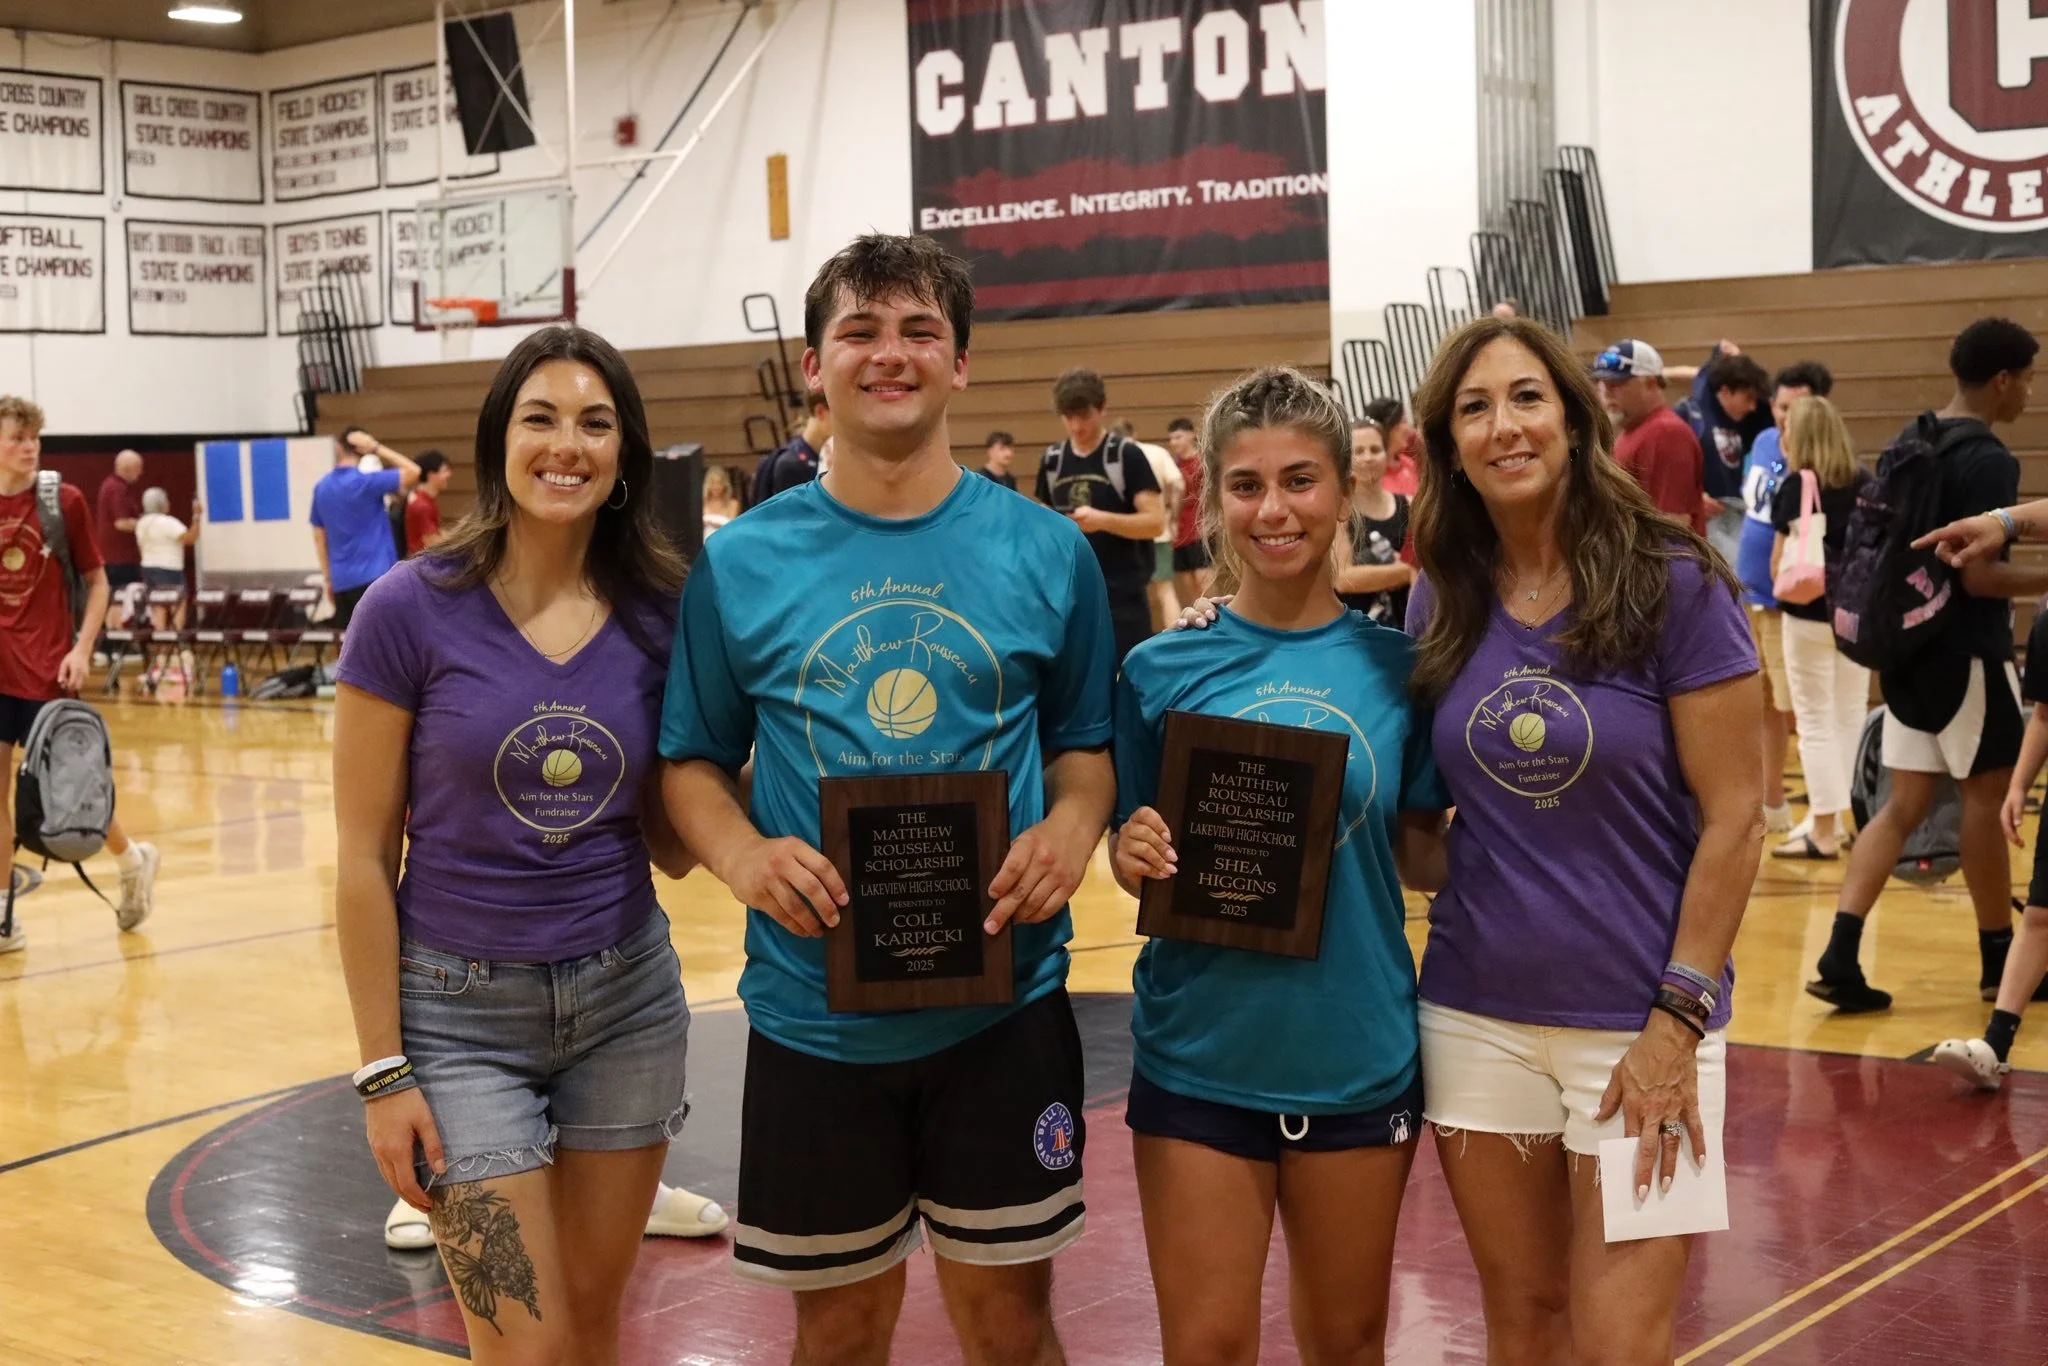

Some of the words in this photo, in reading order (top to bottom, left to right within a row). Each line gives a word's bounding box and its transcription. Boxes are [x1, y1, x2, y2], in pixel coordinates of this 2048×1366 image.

[916, 1, 1326, 137] CANTON
[13, 112, 90, 138] CHAMPIONS
[136, 123, 174, 147] STATE
[1855, 94, 2048, 217] ATHLE
[16, 256, 92, 278] CHAMPIONS
[851, 581, 878, 603] 5th
[878, 577, 944, 599] Annual
[815, 625, 903, 698] Matthew
[907, 611, 978, 685] Rousseau
[1519, 665, 1550, 677] Annual
[1256, 682, 1278, 697] 5th
[1278, 680, 1332, 699] Annual
[533, 701, 549, 713] 5th
[549, 700, 586, 713] Annual
[1479, 691, 1528, 730] Matthew
[509, 725, 565, 764] Matthew
[563, 721, 608, 760] Rousseau
[838, 751, 866, 766] Aim
[872, 751, 893, 766] for
[899, 751, 924, 765] the
[930, 750, 965, 764] Stars
[1499, 761, 1515, 770] Aim
[1517, 758, 1530, 769] for
[1531, 757, 1546, 767] the
[1549, 755, 1569, 765] Stars
[1239, 761, 1266, 775] THE
[1211, 772, 1290, 793] MATTHEW
[1518, 772, 1561, 784] Fundraiser
[519, 793, 537, 801] Aim
[540, 792, 551, 801] for
[555, 792, 569, 802] the
[572, 792, 593, 802] Stars
[1208, 788, 1289, 808] ROUSSEAU
[1534, 796, 1560, 809] 2025
[535, 808, 580, 817] Fundraiser
[898, 812, 926, 825] THE
[1198, 801, 1295, 824] SCHOLARSHIP
[542, 834, 570, 843] 2025
[873, 826, 953, 842] MATTHEW
[1190, 822, 1236, 840] LAKEVIEW
[1236, 828, 1260, 843] HIGH
[1261, 831, 1297, 848] SCHOOL
[873, 841, 955, 857] ROUSSEAU
[1214, 843, 1258, 857] PRESENTED
[1258, 848, 1269, 857] TO
[865, 855, 964, 872] SCHOLARSHIP
[1214, 857, 1264, 876] SHEA
[861, 882, 907, 897] LAKEVIEW
[909, 880, 933, 895] HIGH
[934, 878, 972, 892] SCHOOL
[1198, 872, 1277, 894] HIGGINS
[888, 900, 933, 909] PRESENTED
[935, 898, 946, 906] TO
[1220, 903, 1248, 917] 2025
[892, 912, 943, 928] COLE
[874, 929, 963, 947] KARPICKI
[907, 959, 935, 972] 2025
[366, 1071, 399, 1092] MATTHEW
